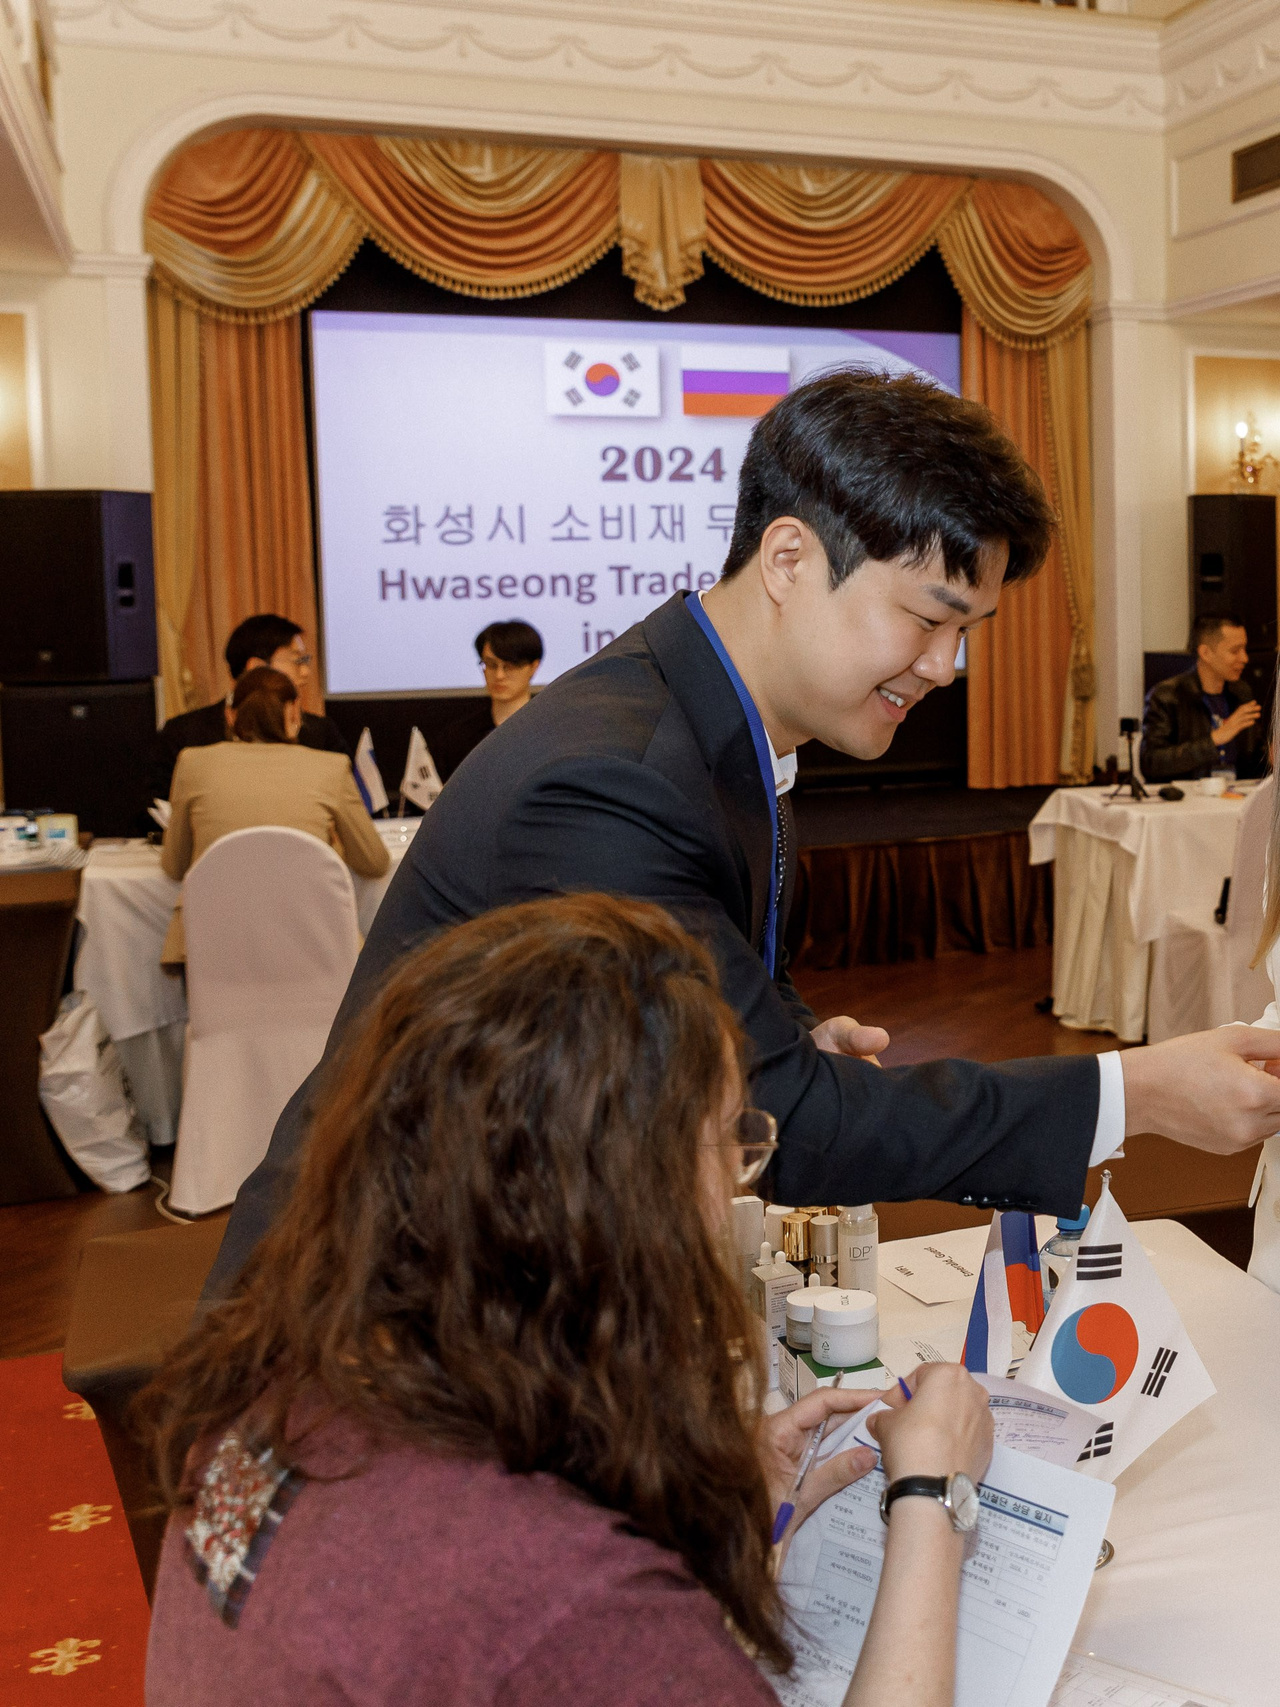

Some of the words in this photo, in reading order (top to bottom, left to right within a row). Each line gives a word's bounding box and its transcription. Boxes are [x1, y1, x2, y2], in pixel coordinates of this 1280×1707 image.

[601, 446, 727, 482] 2024
[382, 504, 526, 545] 화성시
[550, 503, 685, 543] 소비재
[379, 568, 598, 605] Hwaseong
[608, 563, 717, 595] Trade
[583, 621, 617, 653] in
[979, 1487, 1008, 1508] 사절단
